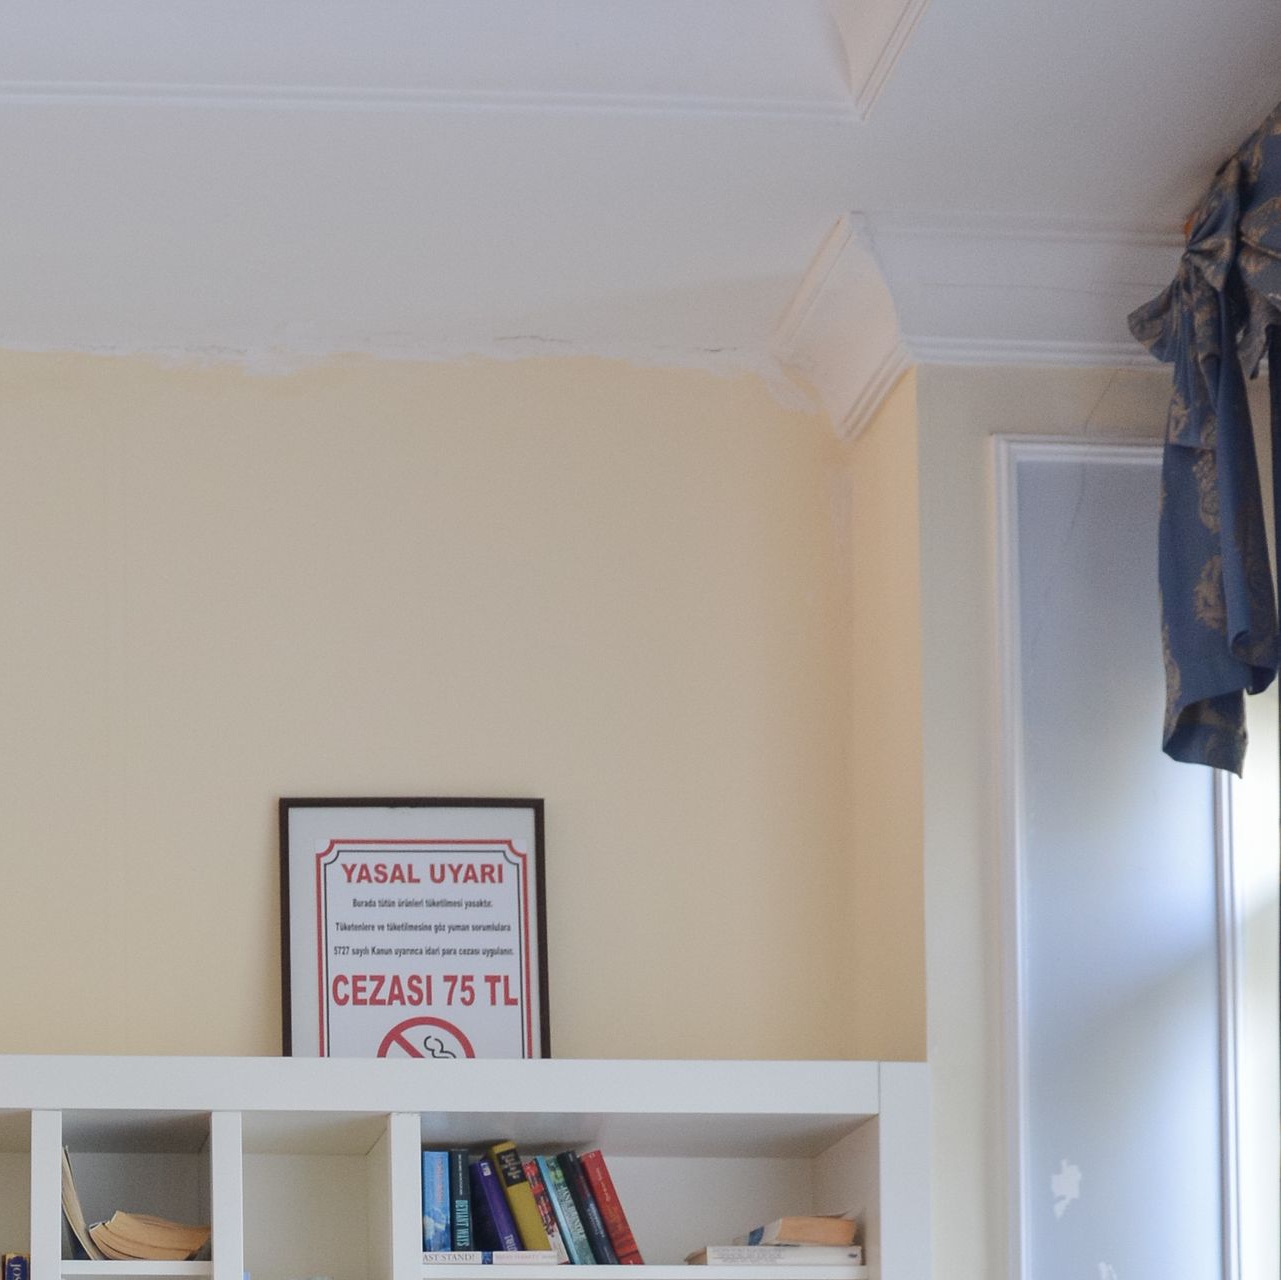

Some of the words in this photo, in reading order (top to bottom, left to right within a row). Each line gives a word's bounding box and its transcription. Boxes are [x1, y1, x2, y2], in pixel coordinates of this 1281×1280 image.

[342, 863, 421, 884] YASAL
[430, 863, 503, 884] UYARI
[352, 898, 376, 908] Burada
[425, 898, 463, 908] tüketilmesi
[335, 922, 375, 932] Tüketenlere
[377, 924, 385, 932] ve
[387, 922, 432, 932] tüketilmesine
[447, 924, 469, 934] yuman
[334, 946, 349, 955] 5727
[371, 946, 393, 955] Kanun
[441, 948, 458, 958] para
[332, 974, 432, 1006] CEZASI
[443, 974, 475, 1006] 75
[484, 974, 518, 1006] TL
